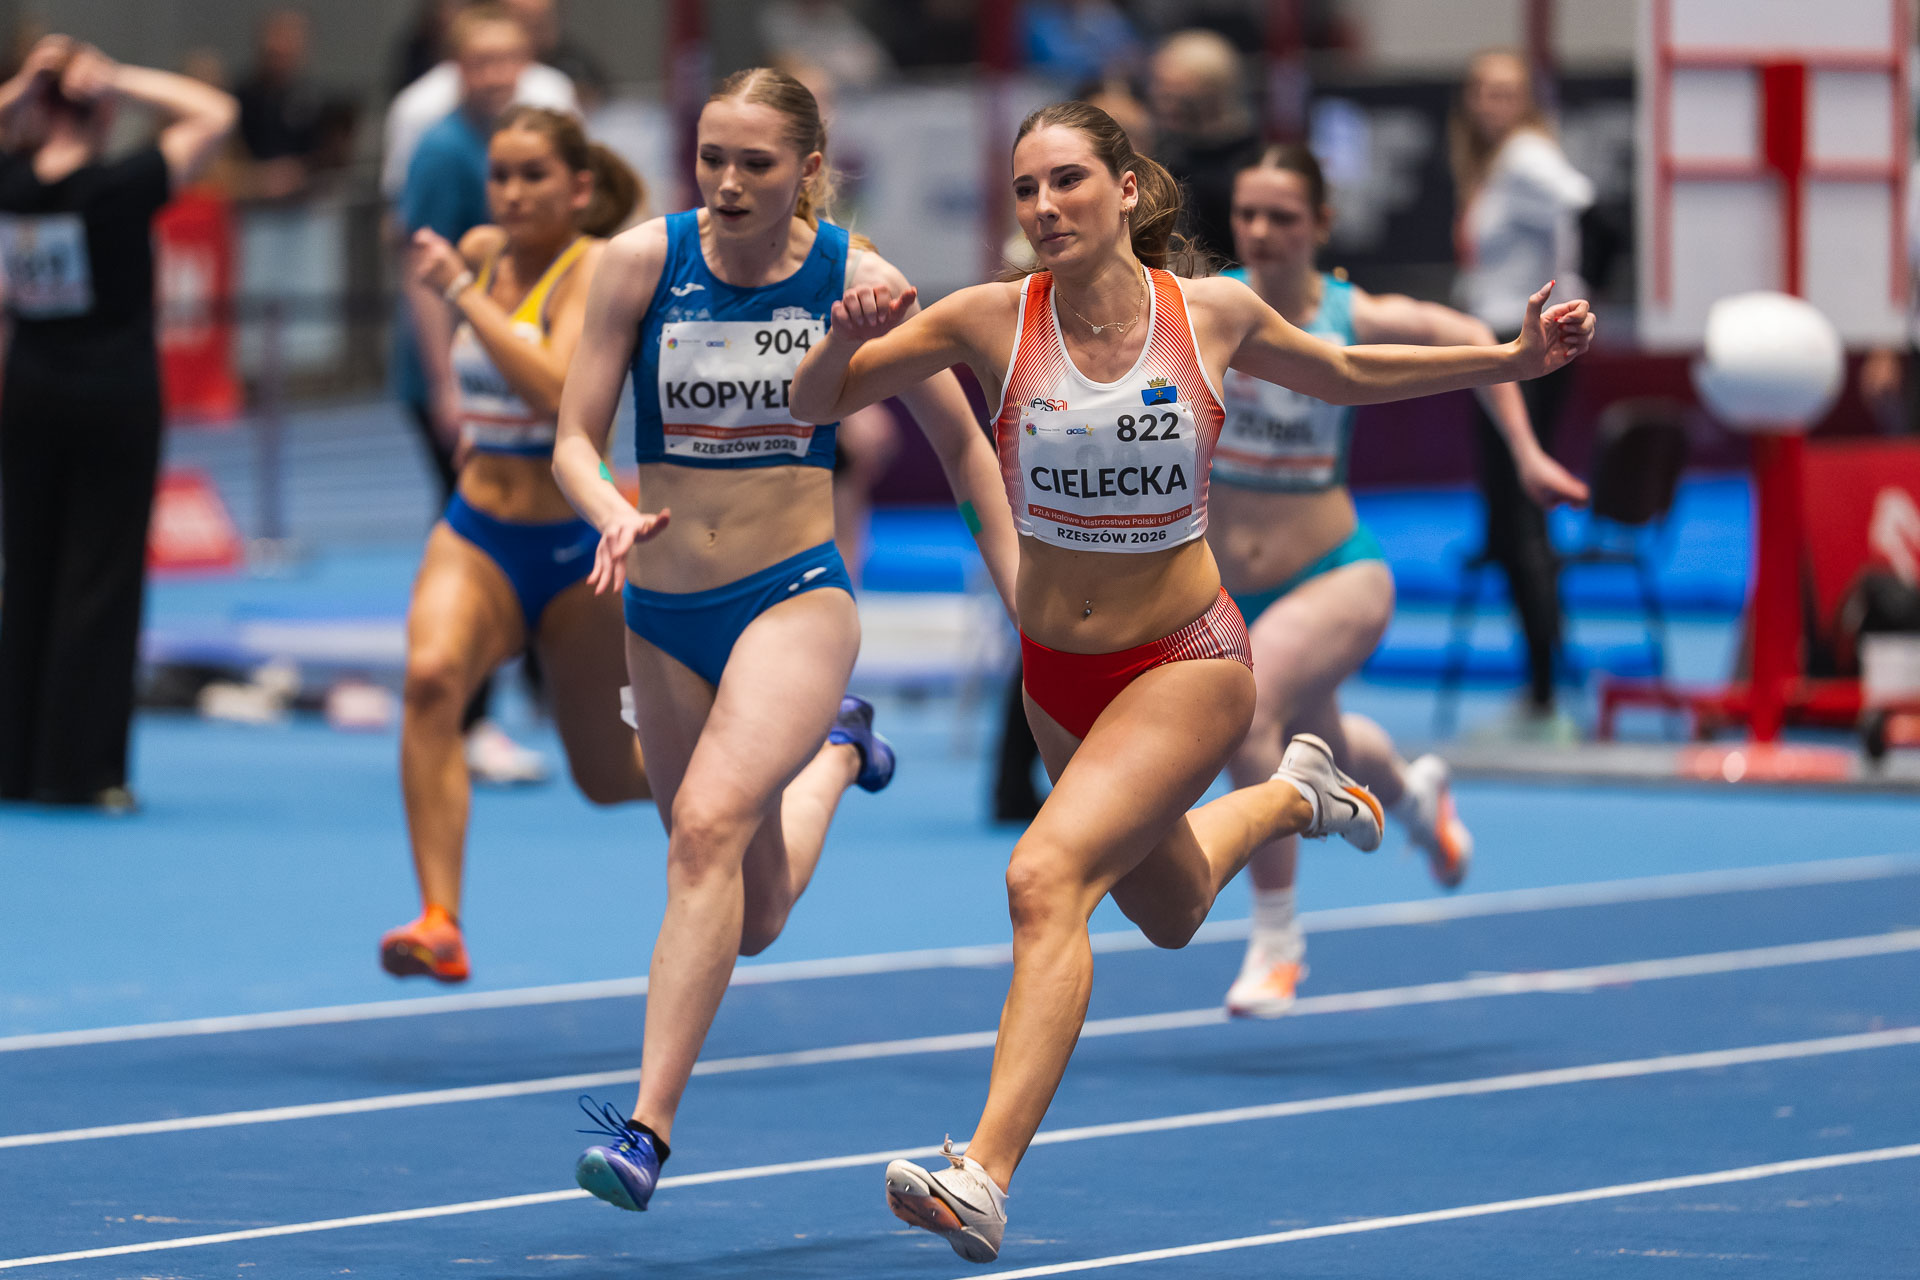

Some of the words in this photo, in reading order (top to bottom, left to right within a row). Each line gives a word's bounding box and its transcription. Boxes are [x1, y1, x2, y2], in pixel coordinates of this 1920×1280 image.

[754, 328, 811, 356] 904
[1116, 412, 1180, 442] 822
[693, 440, 761, 454] RZESZÓW
[764, 439, 797, 451] 2026
[1030, 464, 1187, 498] CIELECKA
[1033, 507, 1050, 518] PZLA
[1051, 512, 1080, 524] Halowe
[1081, 517, 1131, 526] Mistrzostwa
[1132, 517, 1157, 525] Polski
[1158, 515, 1172, 524] U18
[1176, 508, 1190, 518] U20
[1057, 527, 1127, 543] RZESZÓW
[1130, 530, 1167, 543] 2026
